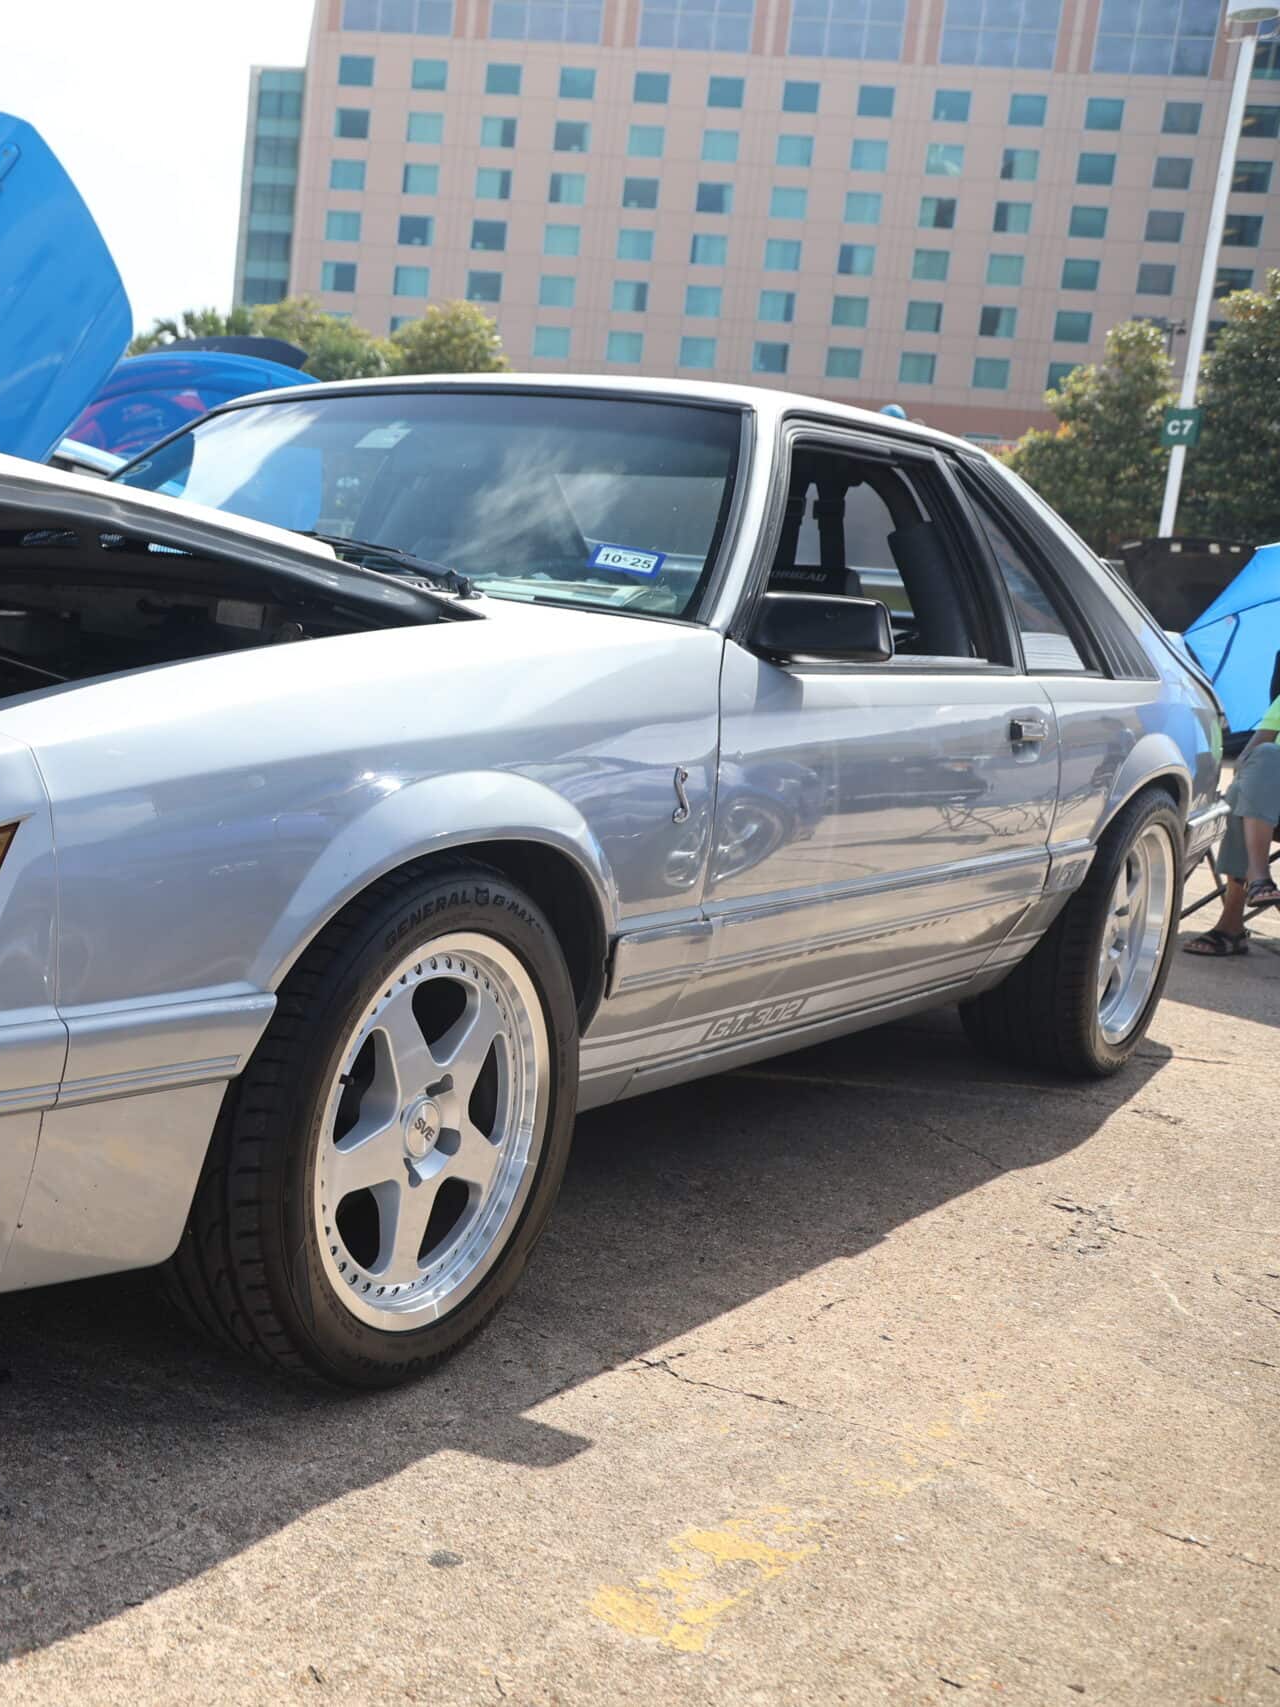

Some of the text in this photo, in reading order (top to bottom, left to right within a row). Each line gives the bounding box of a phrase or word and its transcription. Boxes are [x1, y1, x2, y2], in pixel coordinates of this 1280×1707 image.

[1166, 419, 1193, 436] C7
[385, 889, 472, 946] GENERAL
[414, 1117, 436, 1143] SVE
